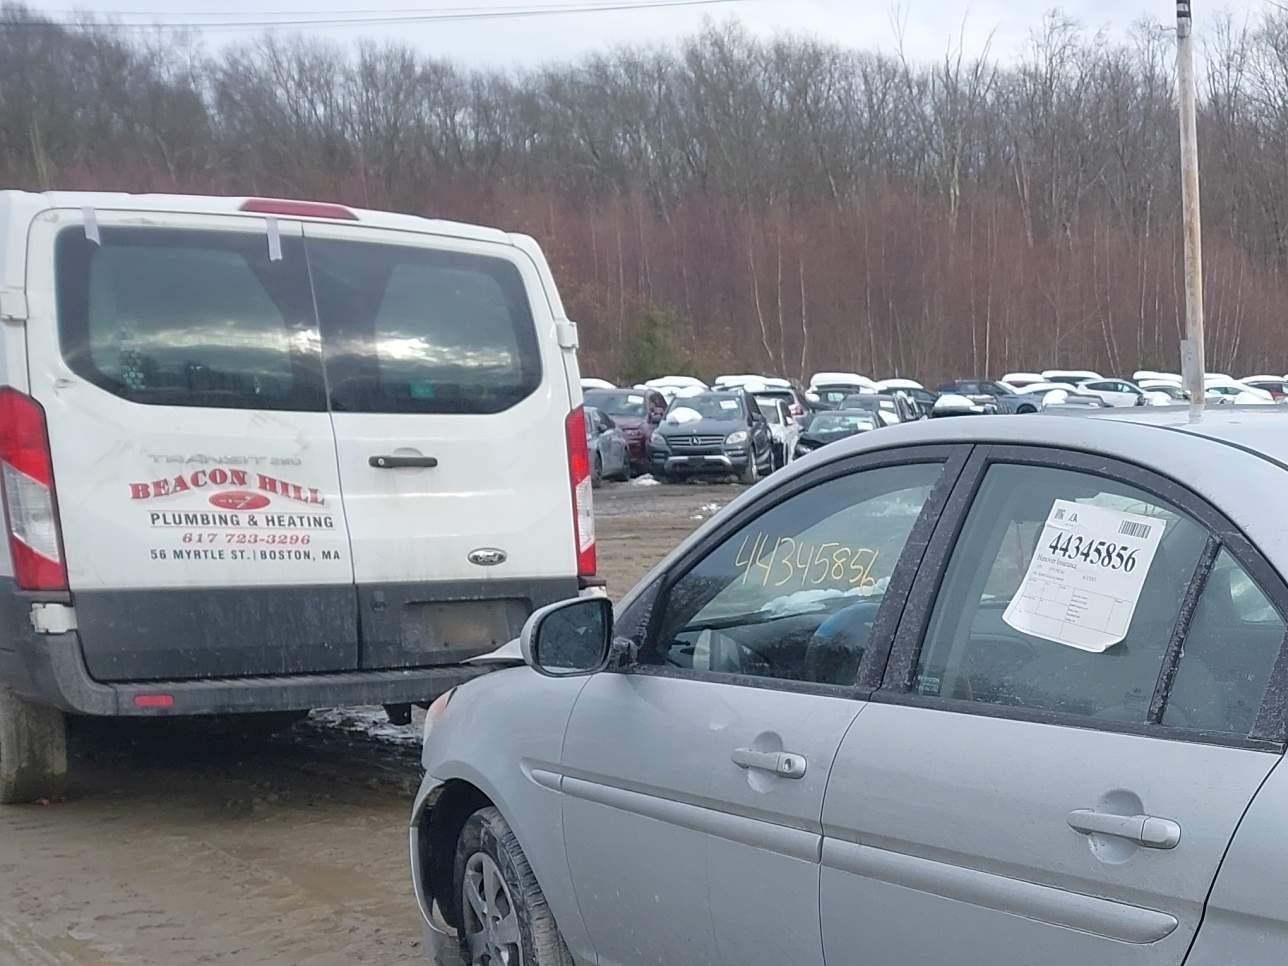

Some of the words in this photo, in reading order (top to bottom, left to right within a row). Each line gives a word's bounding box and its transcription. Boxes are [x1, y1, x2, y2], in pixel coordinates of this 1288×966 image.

[128, 467, 248, 500] BEACON
[255, 472, 326, 506] HILL
[150, 512, 241, 528] PLUMBING
[247, 514, 259, 527] &
[265, 515, 334, 529] HEATING
[182, 533, 218, 545] 617
[225, 533, 311, 546] 723-3296
[1048, 531, 1142, 573] 44345856
[150, 549, 168, 561] 56
[173, 549, 226, 561] MYRTLE
[321, 550, 341, 561] MA
[735, 531, 880, 592] 44345856
